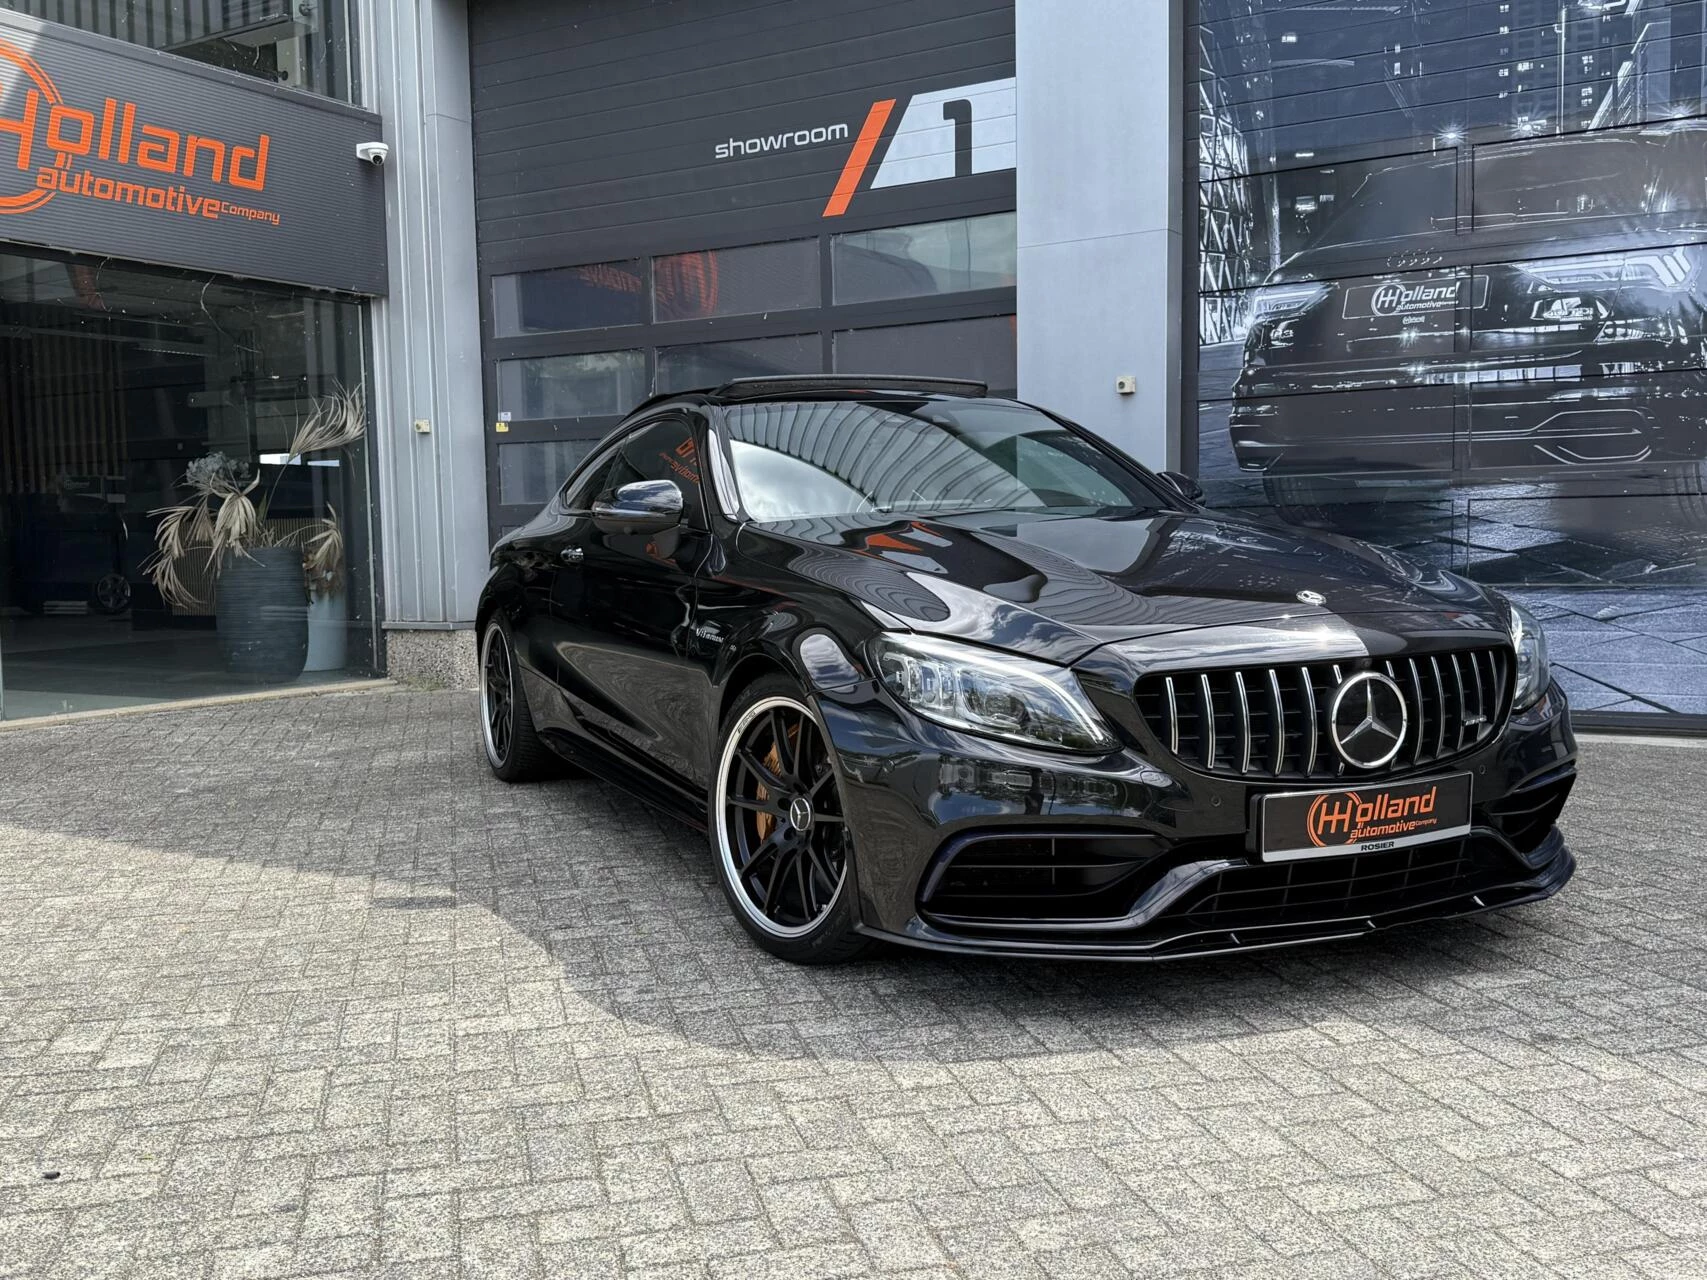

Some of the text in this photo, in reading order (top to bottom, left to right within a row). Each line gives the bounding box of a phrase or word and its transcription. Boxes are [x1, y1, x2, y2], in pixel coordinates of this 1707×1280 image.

[714, 123, 849, 159] showroom
[36, 166, 280, 225] automotive Company
[1376, 281, 1461, 309] Holland
[1317, 786, 1437, 834] Holland
[1350, 820, 1416, 839] automotive
[1360, 841, 1395, 852] ROSIER
